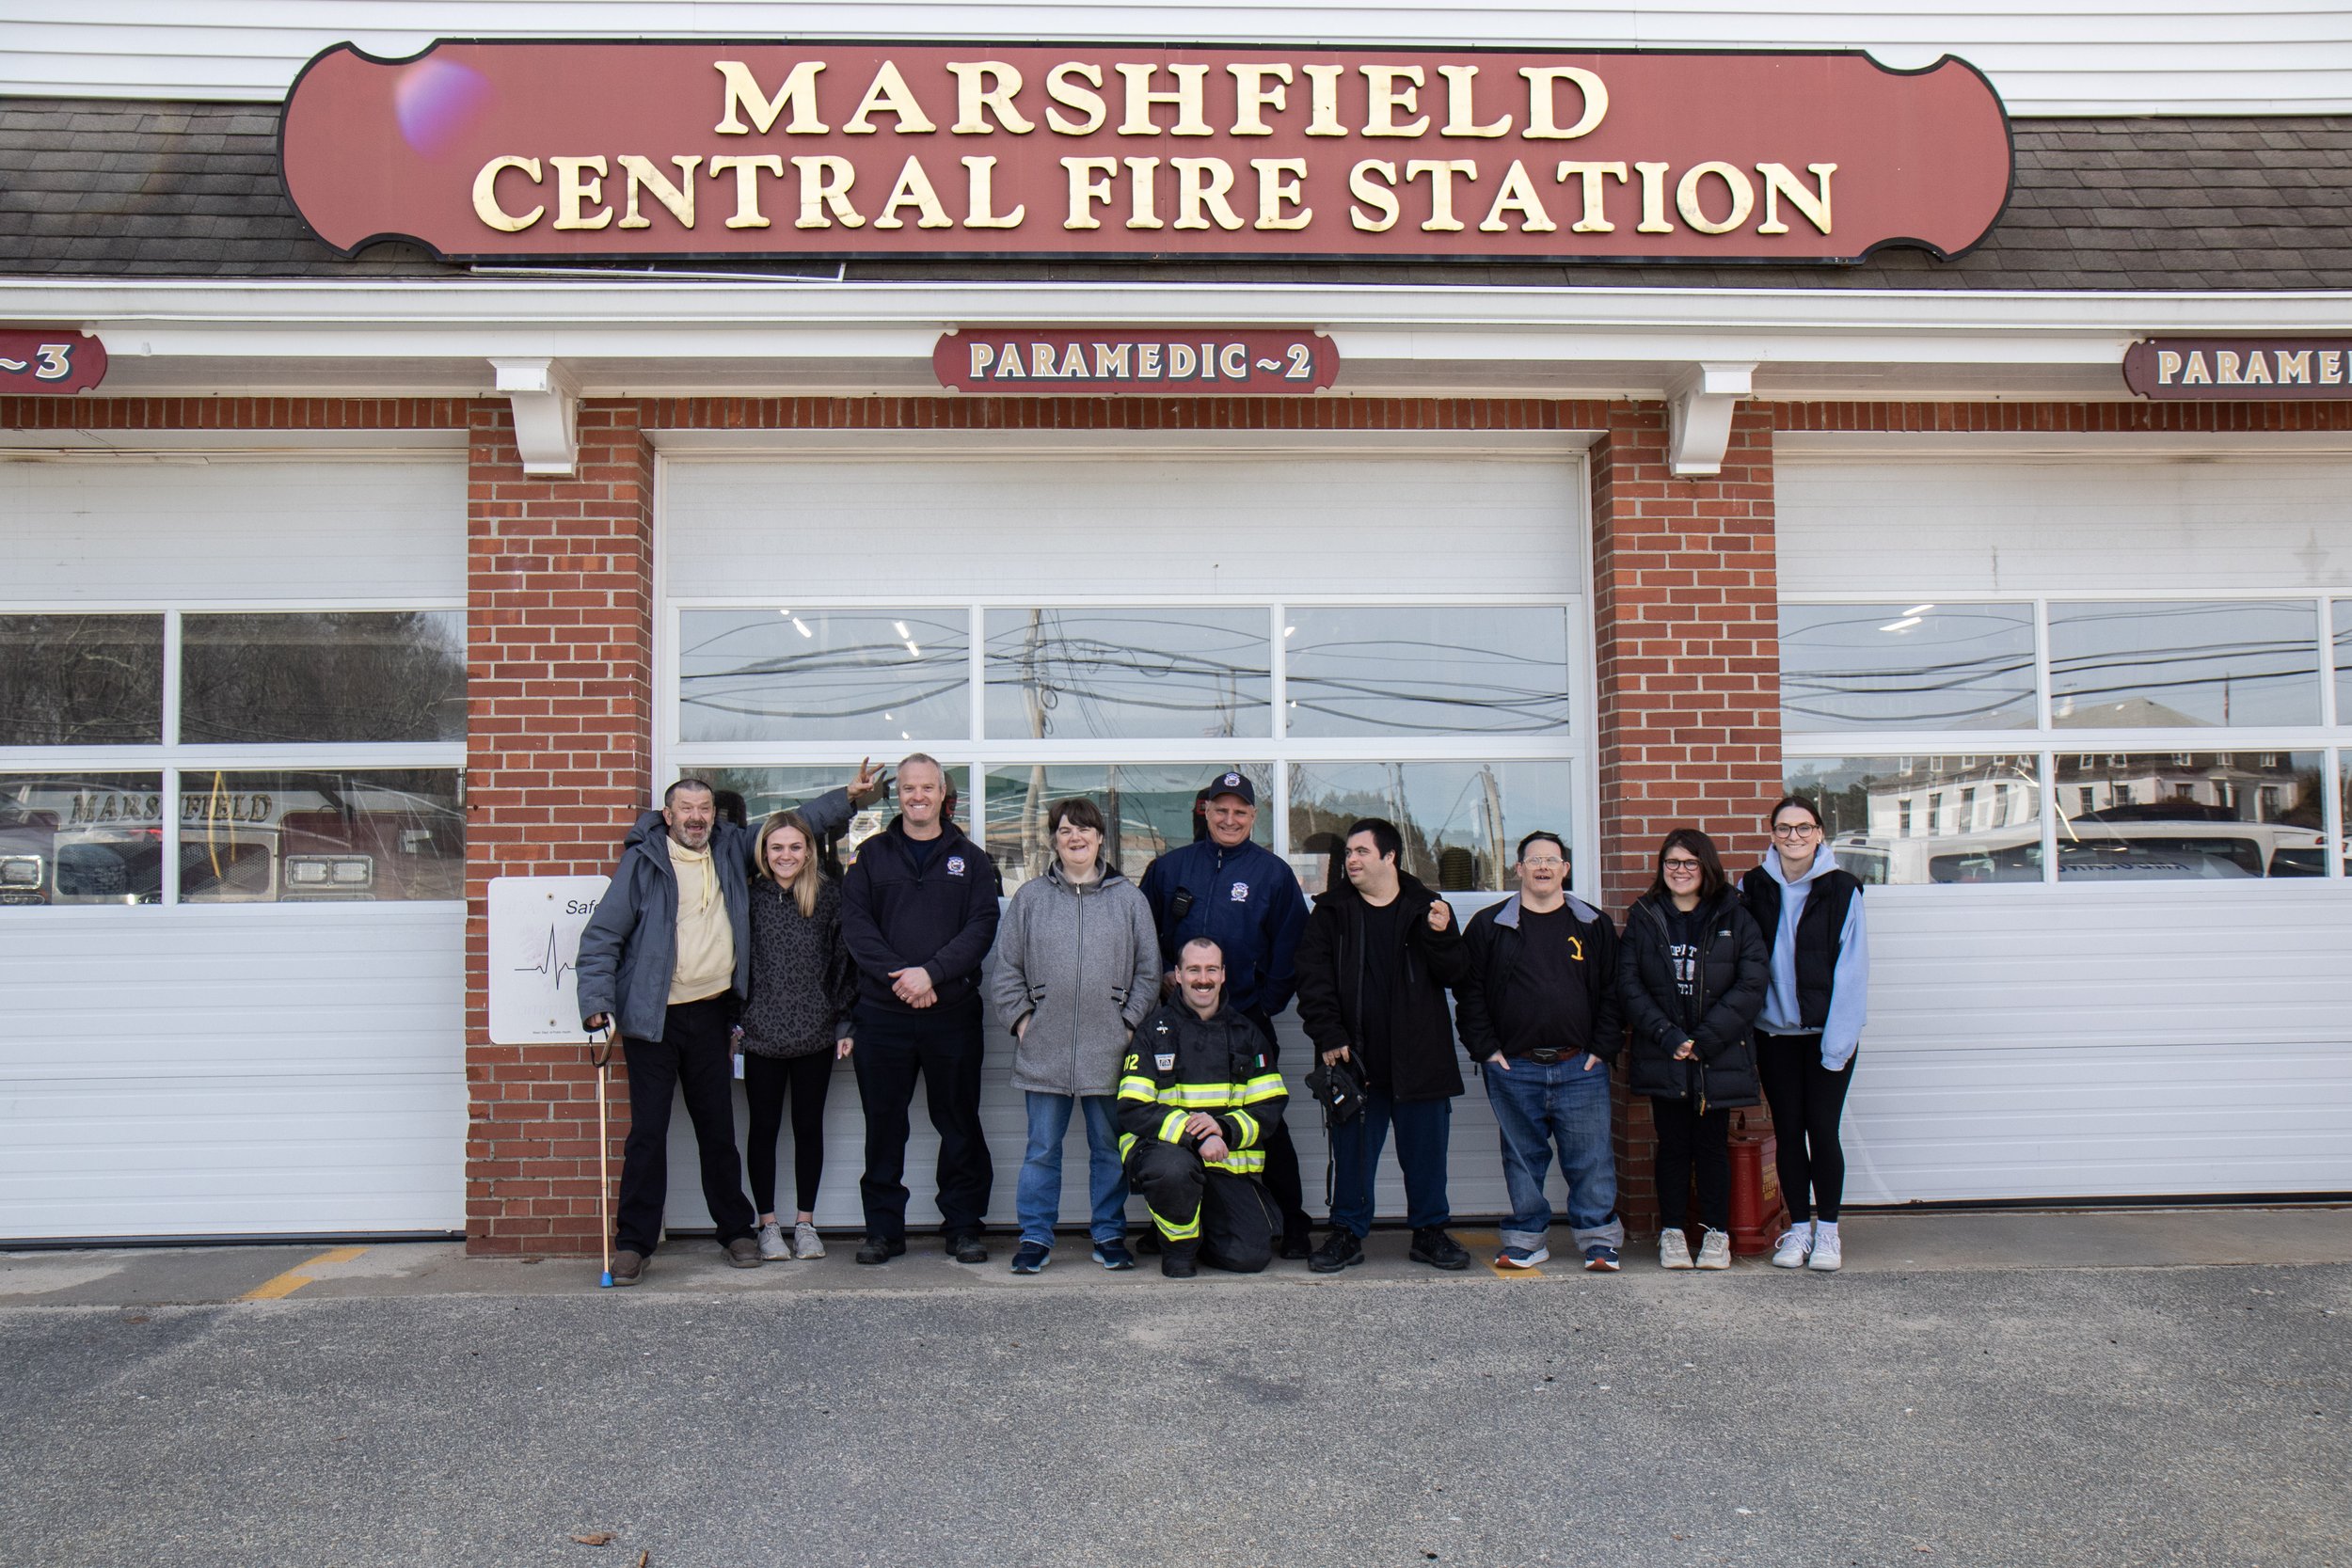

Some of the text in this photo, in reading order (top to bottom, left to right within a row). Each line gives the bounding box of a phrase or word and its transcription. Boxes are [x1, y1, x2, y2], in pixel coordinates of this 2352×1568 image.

[714, 61, 1610, 140] MARSHFIELD
[472, 155, 1839, 235] CENTRAL FIRE STATION
[2156, 350, 2352, 386] PARAME
[69, 793, 273, 824] MARSFIELD
